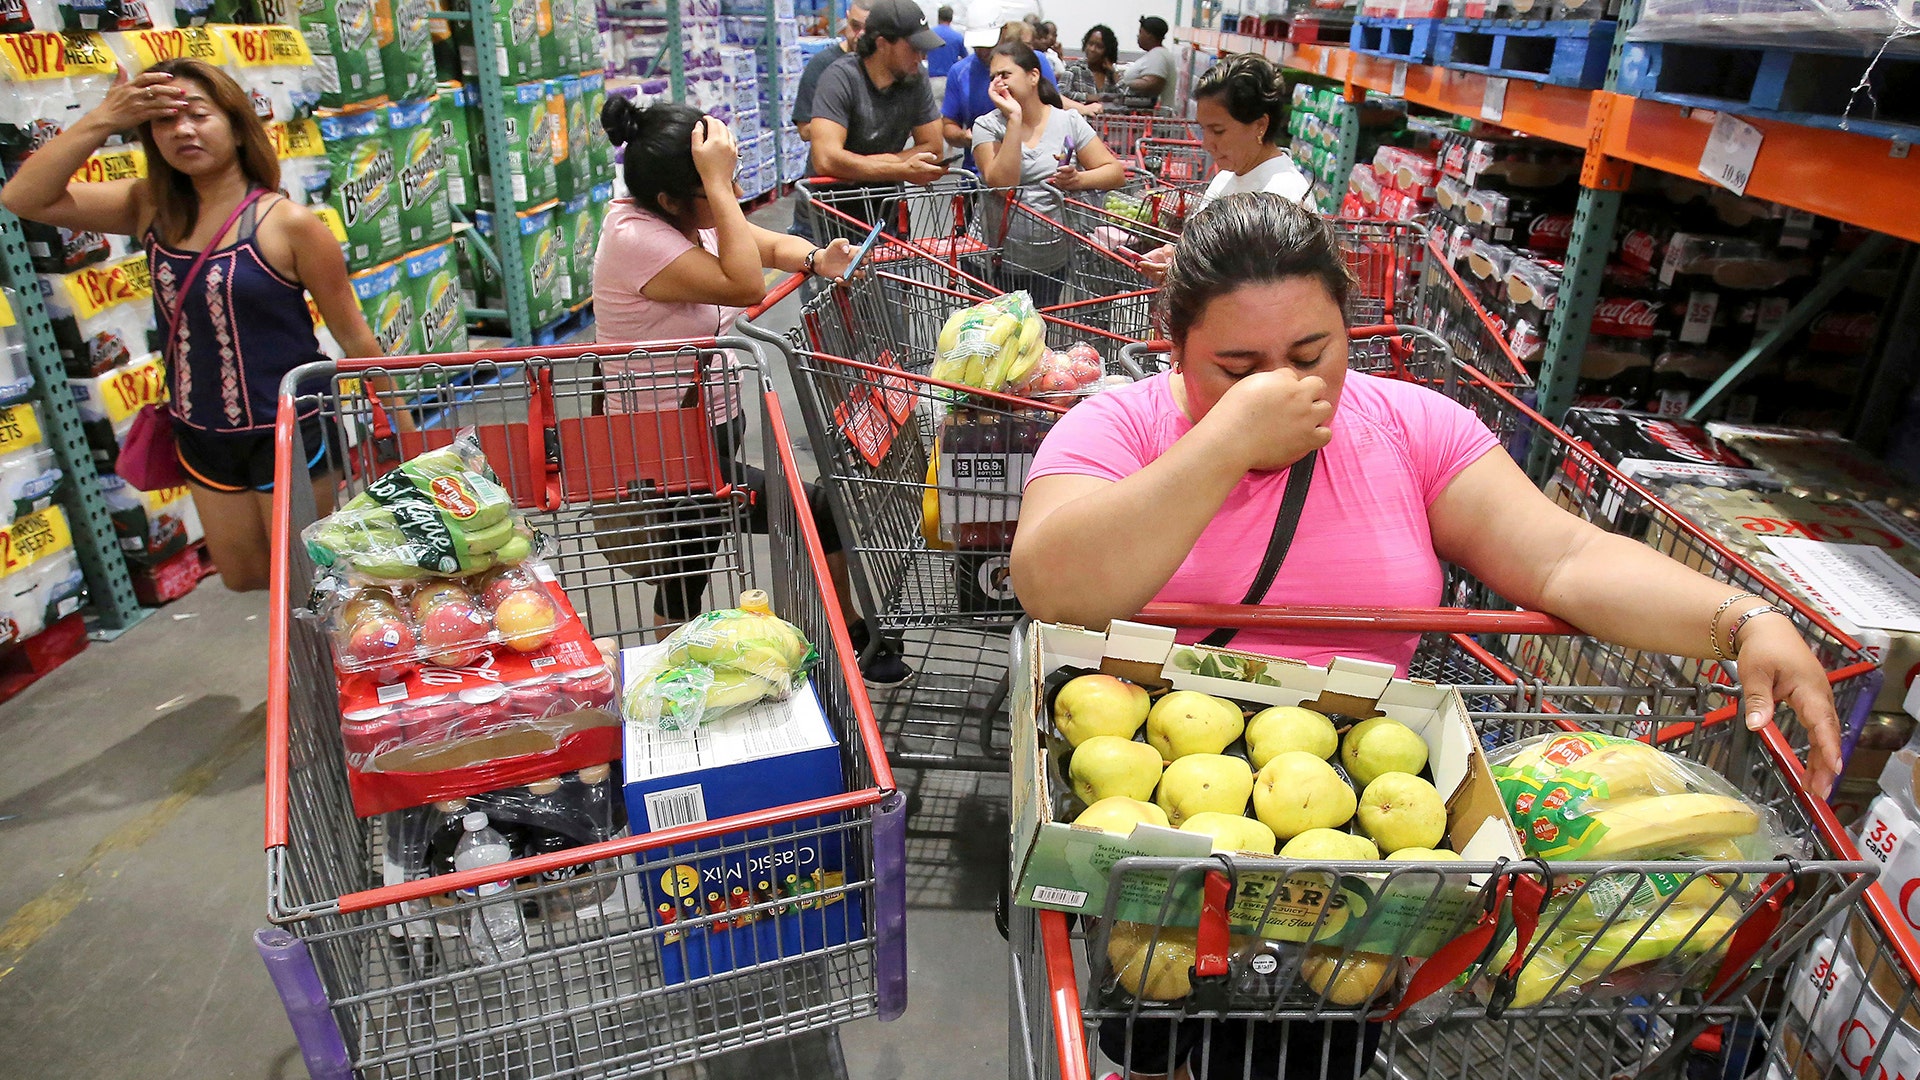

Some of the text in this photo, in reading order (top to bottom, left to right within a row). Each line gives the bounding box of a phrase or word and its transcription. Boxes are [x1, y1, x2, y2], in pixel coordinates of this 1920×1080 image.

[6, 33, 65, 75] 1872
[65, 50, 107, 65] HEETS
[140, 30, 184, 62] 1872
[339, 147, 395, 228] Bounty
[398, 136, 446, 211] Bounty
[421, 275, 461, 352] Bounty
[112, 364, 167, 411] 1872
[977, 461, 999, 471] 16.9
[1651, 465, 1694, 475] PACK
[436, 477, 473, 516] Del Monte
[1865, 837, 1888, 864] cans
[1870, 819, 1898, 853] 35
[703, 846, 815, 884] Cassic Mix
[1262, 875, 1315, 887] BATLETT
[1240, 881, 1349, 909] EARS
[1656, 873, 1674, 891] 011
